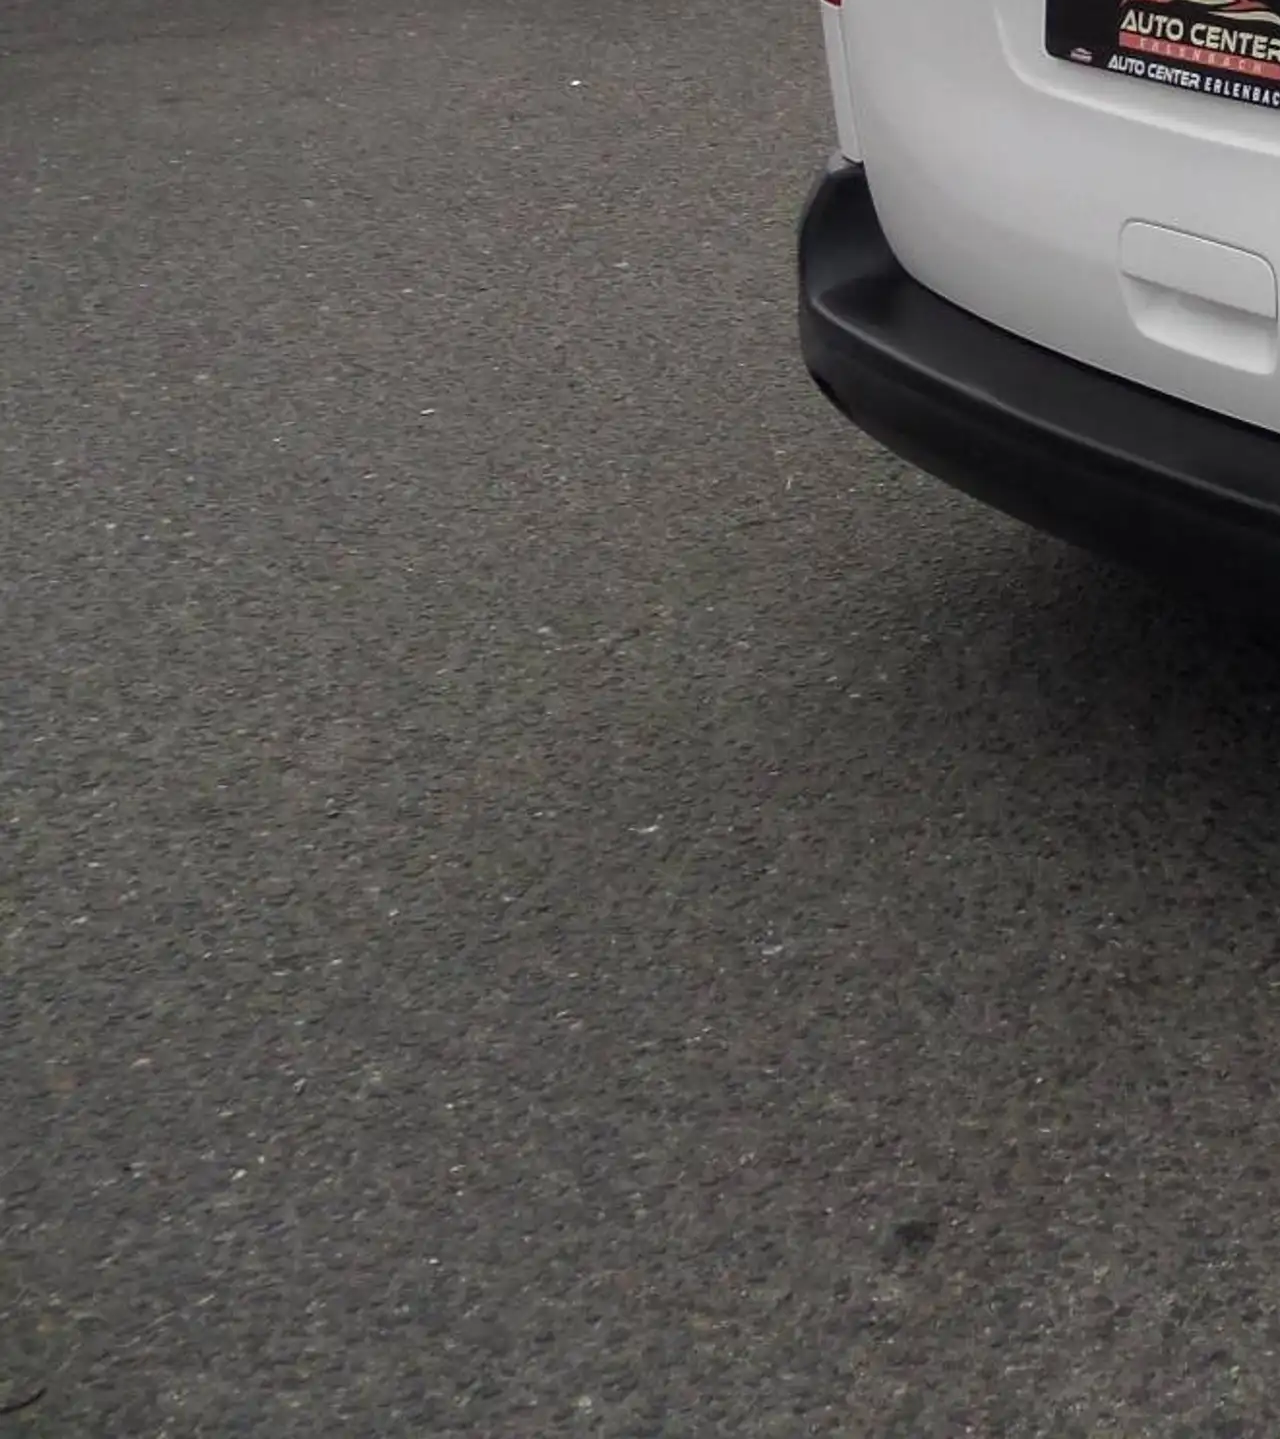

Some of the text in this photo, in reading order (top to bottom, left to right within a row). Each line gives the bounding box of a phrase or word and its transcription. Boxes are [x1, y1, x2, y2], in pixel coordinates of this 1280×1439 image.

[1120, 8, 1185, 42] AUTO
[1107, 53, 1145, 77] AUTO
[1147, 62, 1200, 90] CENTER
